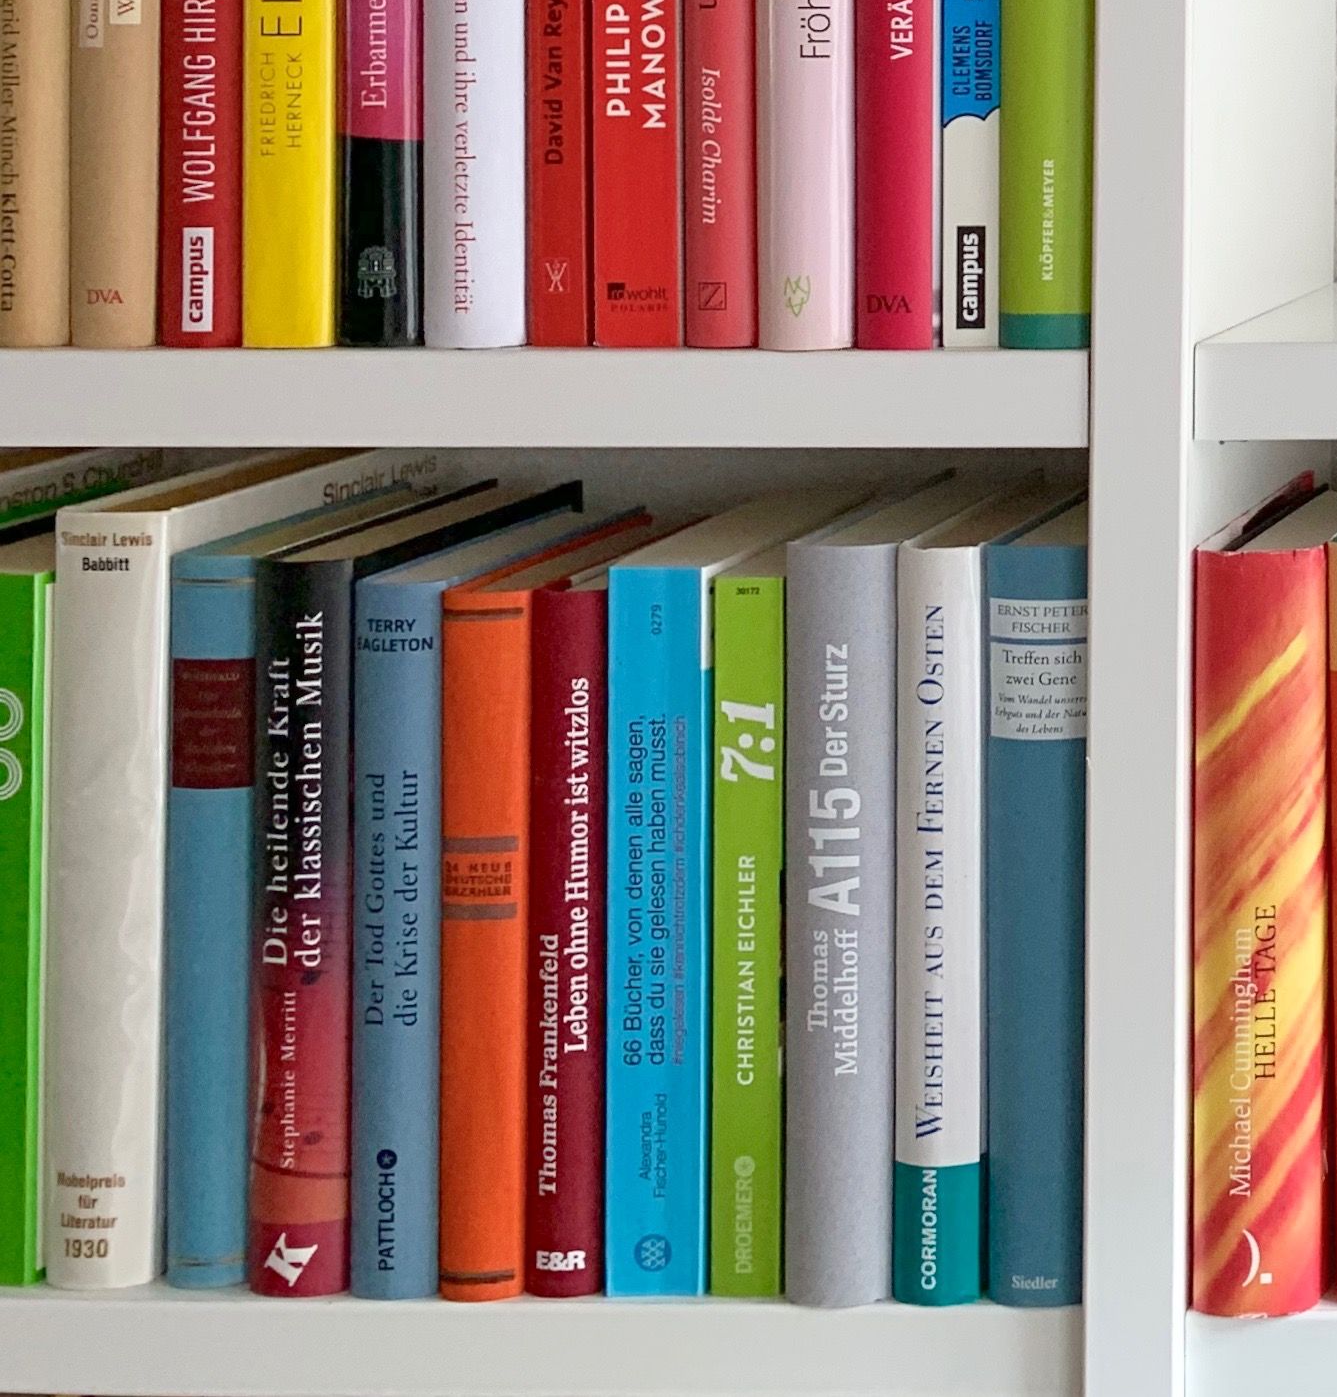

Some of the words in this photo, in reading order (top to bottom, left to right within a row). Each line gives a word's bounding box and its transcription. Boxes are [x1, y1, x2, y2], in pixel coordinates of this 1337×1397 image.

[606, 4, 630, 116] PHILIP
[183, 55, 215, 202] WOLFGANG
[188, 233, 205, 324] campus
[960, 233, 979, 324] campus
[82, 556, 130, 573] Babbitt
[565, 678, 589, 769] witzlos
[824, 644, 847, 722] Sturz
[564, 773, 588, 805] ist
[822, 728, 847, 777] Der
[565, 811, 588, 902] Humor
[809, 786, 860, 915] A115
[564, 907, 588, 969] ohne
[738, 856, 755, 951] EICHLER
[563, 973, 588, 1053] Leben
[737, 961, 754, 1085] CHRISTIAN
[834, 930, 859, 1076] Middelhoff
[920, 1168, 938, 1290] CORMORAN
